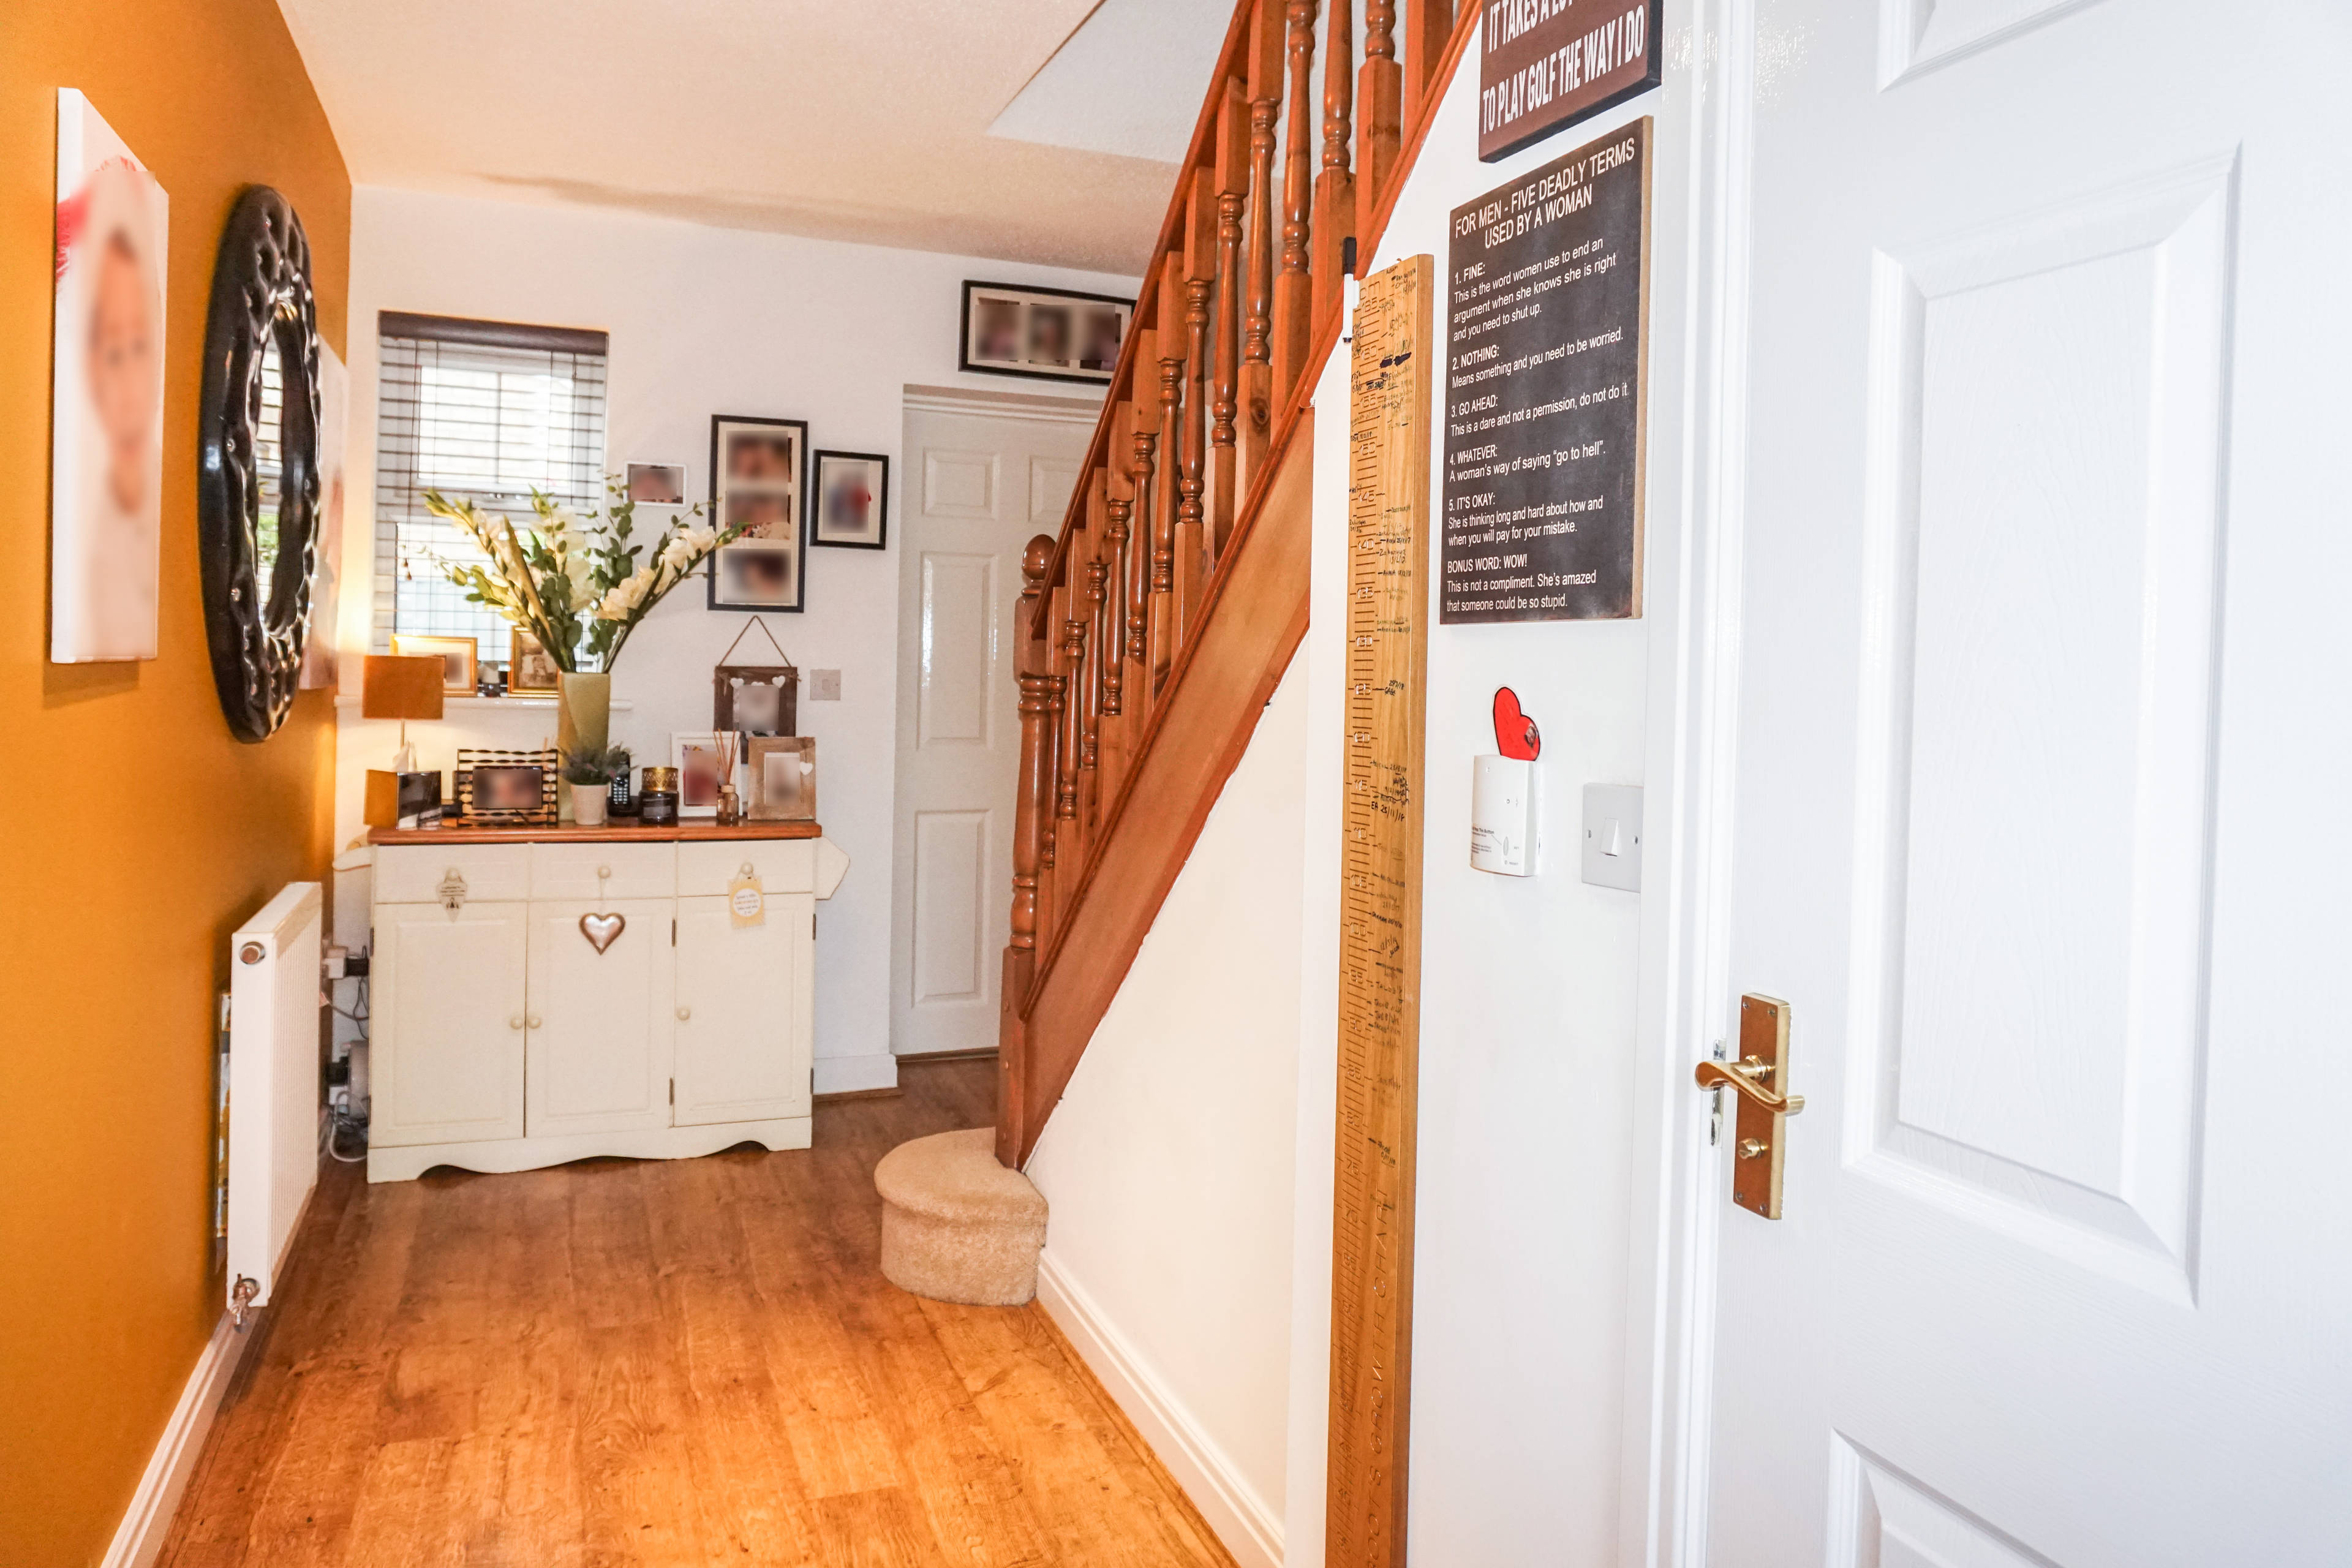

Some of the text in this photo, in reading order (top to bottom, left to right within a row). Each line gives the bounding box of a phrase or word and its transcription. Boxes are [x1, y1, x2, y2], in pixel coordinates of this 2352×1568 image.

[1488, 1, 1500, 53] IT
[1483, 5, 1644, 134] TO PLAY GOLF THE WAY I DO
[1455, 213, 1477, 238] FOR
[1479, 200, 1502, 228] MEN
[1511, 184, 1536, 213] FIVE
[1539, 160, 1587, 201] DEADLY
[1589, 138, 1635, 177] TERMS
[1485, 184, 1593, 249] USED BY A WOMAN
[1453, 239, 1604, 304] This is the word women use to end an
[1455, 262, 1485, 284] 1. FINE:
[1360, 281, 1380, 300] cm
[1453, 252, 1616, 323] argument when she knows she is right
[1453, 304, 1542, 341] and you need to shut up.
[1452, 344, 1500, 370] 2. NOTHING:
[1452, 326, 1624, 388] Means something and you need to be worried.
[1450, 423, 1465, 436] This
[1466, 421, 1472, 434] is
[1473, 422, 1479, 431] a
[1479, 417, 1496, 430] dare
[1496, 411, 1511, 426] and
[1512, 408, 1525, 423] not
[1525, 409, 1531, 419] a
[1532, 397, 1577, 421] permission,
[1579, 392, 1591, 406] do
[1592, 388, 1607, 403] not
[1608, 385, 1620, 399] do
[1451, 394, 1499, 418] 3. GO AHEAD:
[1359, 442, 1376, 456] 150
[1449, 445, 1498, 466] 4. WHATEVER:
[1449, 470, 1456, 483] A
[1457, 464, 1491, 481] woman's
[1493, 462, 1510, 475] way
[1512, 457, 1521, 470] of
[1522, 453, 1551, 470] saying
[1570, 447, 1580, 460] to
[1358, 490, 1375, 502] 145
[1449, 492, 1496, 511] 5. IT'S OKAY:
[1448, 495, 1604, 529] She is thinking long and hard about how and
[1357, 538, 1374, 550] 140
[1448, 519, 1578, 547] when you will pay for your mistake.
[1447, 554, 1528, 573] BONUS WORD: WOW!
[1357, 587, 1373, 598] 135
[1447, 570, 1597, 592] This is not a compliment. She's amazed
[1446, 594, 1568, 612] that someone could be so stupid.
[1354, 684, 1371, 695] 125
[1354, 731, 1370, 743] 120
[1351, 875, 1367, 888] 105
[1350, 922, 1366, 936] 100
[1370, 1310, 1385, 1454] GROWTH
